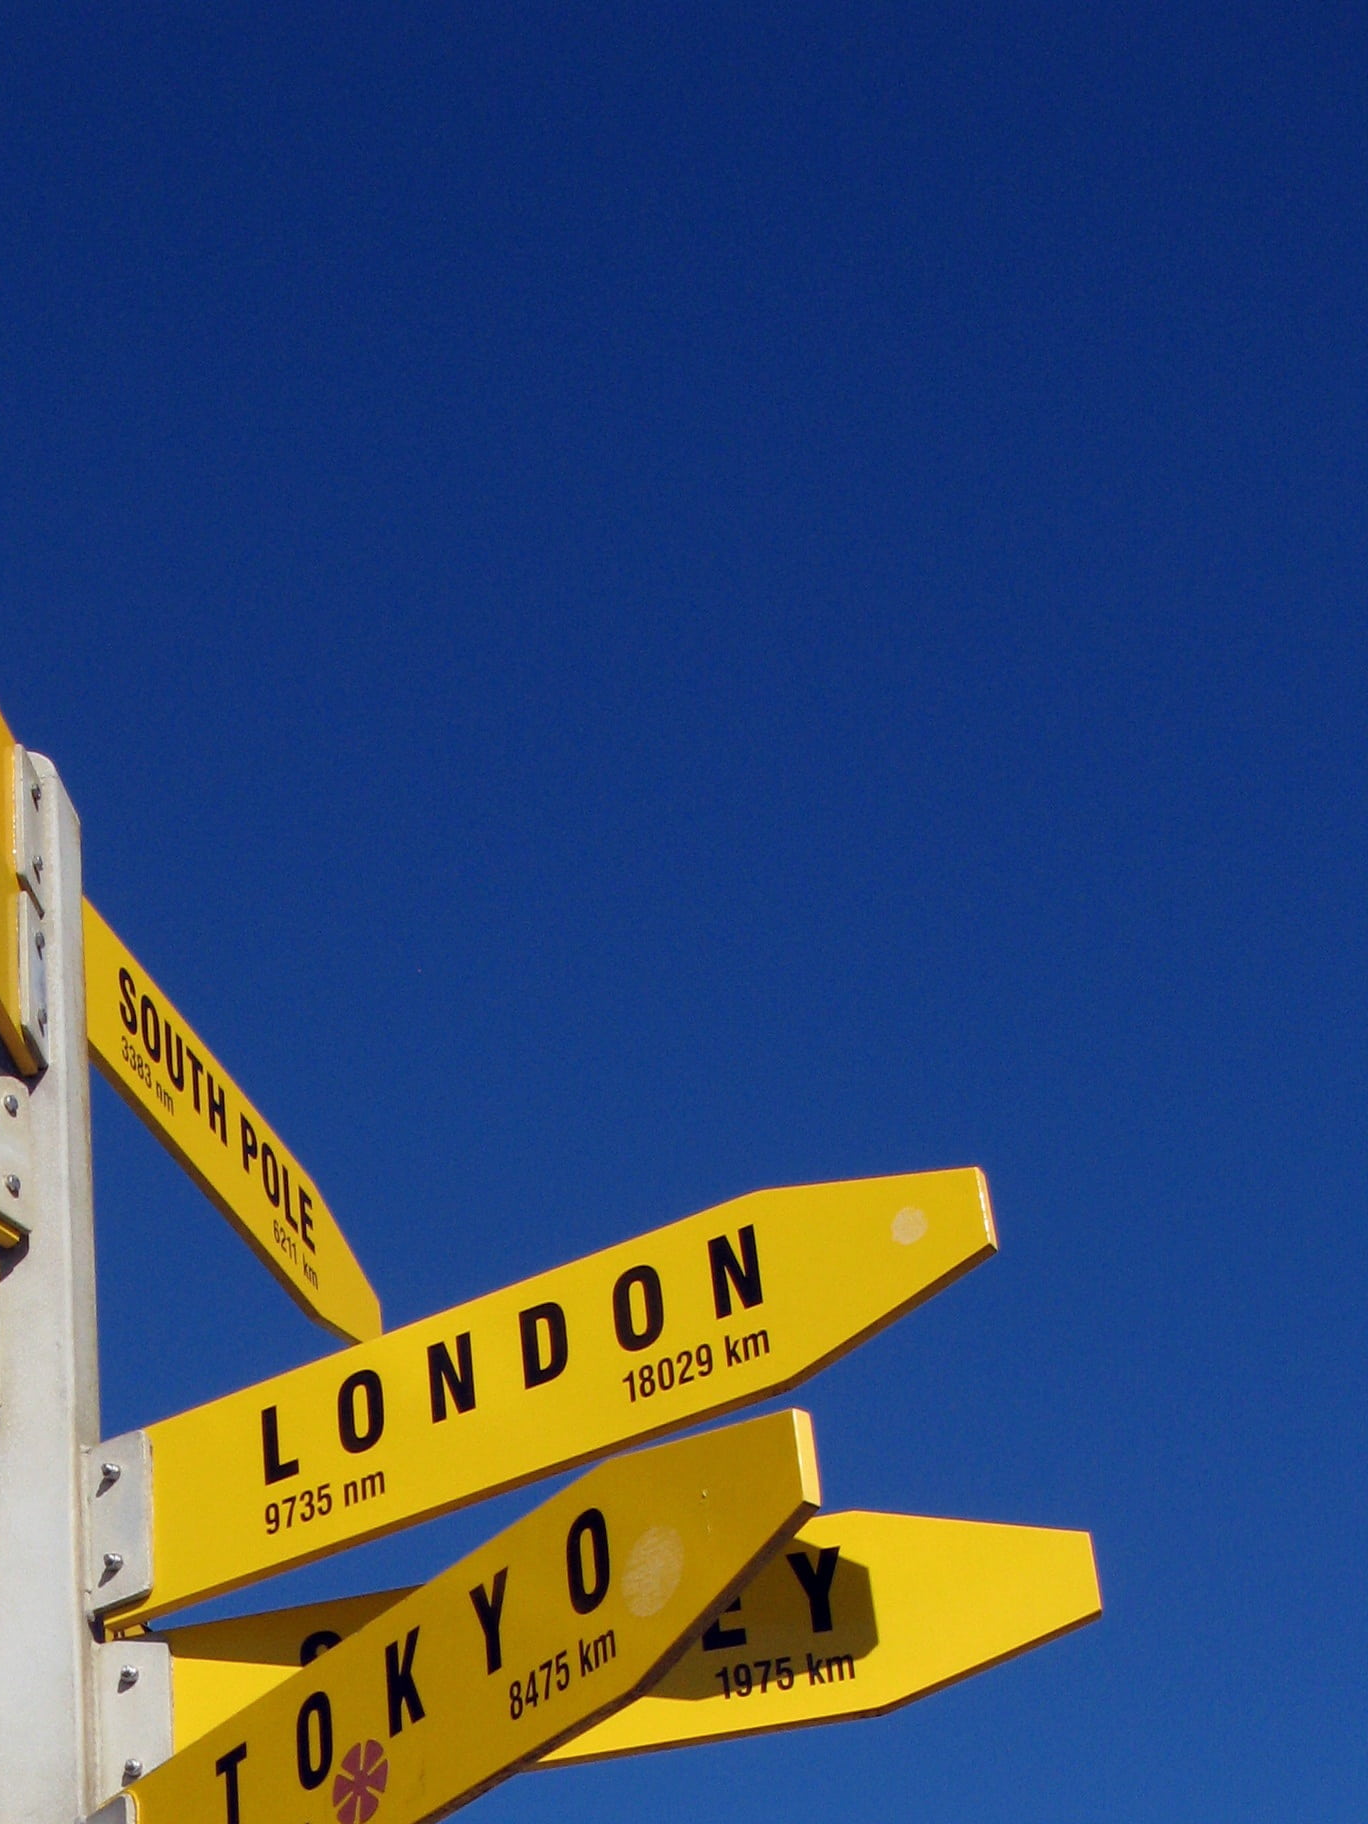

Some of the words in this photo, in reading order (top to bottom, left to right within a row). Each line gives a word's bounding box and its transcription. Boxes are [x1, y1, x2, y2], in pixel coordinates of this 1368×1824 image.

[119, 967, 227, 1147] SOUTH
[240, 1112, 315, 1254] POLE
[120, 1035, 152, 1089] 3383
[156, 1081, 174, 1116] nm
[273, 1220, 297, 1264] 6211
[302, 1253, 318, 1290] km
[261, 1224, 764, 1485] LONDON
[622, 1343, 715, 1403] 18029
[727, 1329, 771, 1367] km
[264, 1482, 333, 1535] 9735
[343, 1470, 385, 1508] nm
[508, 1650, 572, 1721] 8475
[581, 1628, 617, 1681] km
[715, 1657, 794, 1699] 1975
[806, 1653, 855, 1685] km
